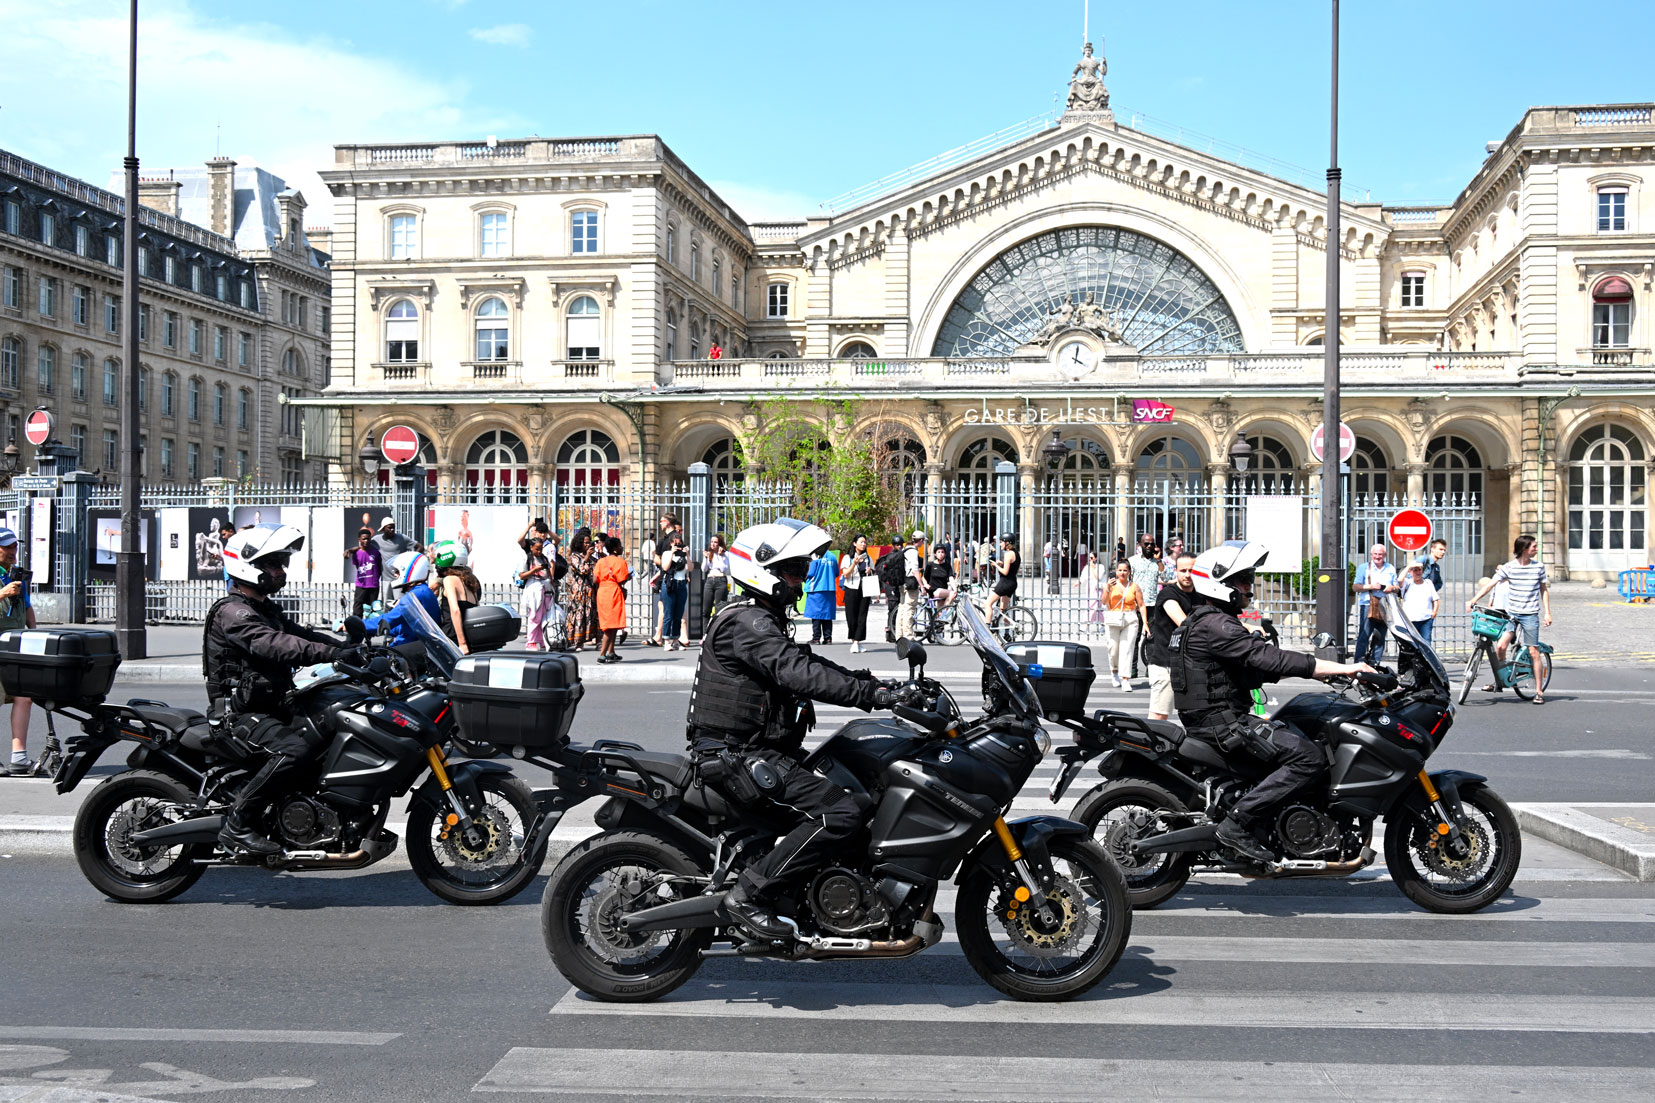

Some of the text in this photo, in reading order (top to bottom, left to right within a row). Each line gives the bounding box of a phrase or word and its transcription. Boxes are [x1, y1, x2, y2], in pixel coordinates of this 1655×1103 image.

[964, 407, 1109, 424] GARE DE L'EST
[1133, 407, 1173, 420] SNCF
